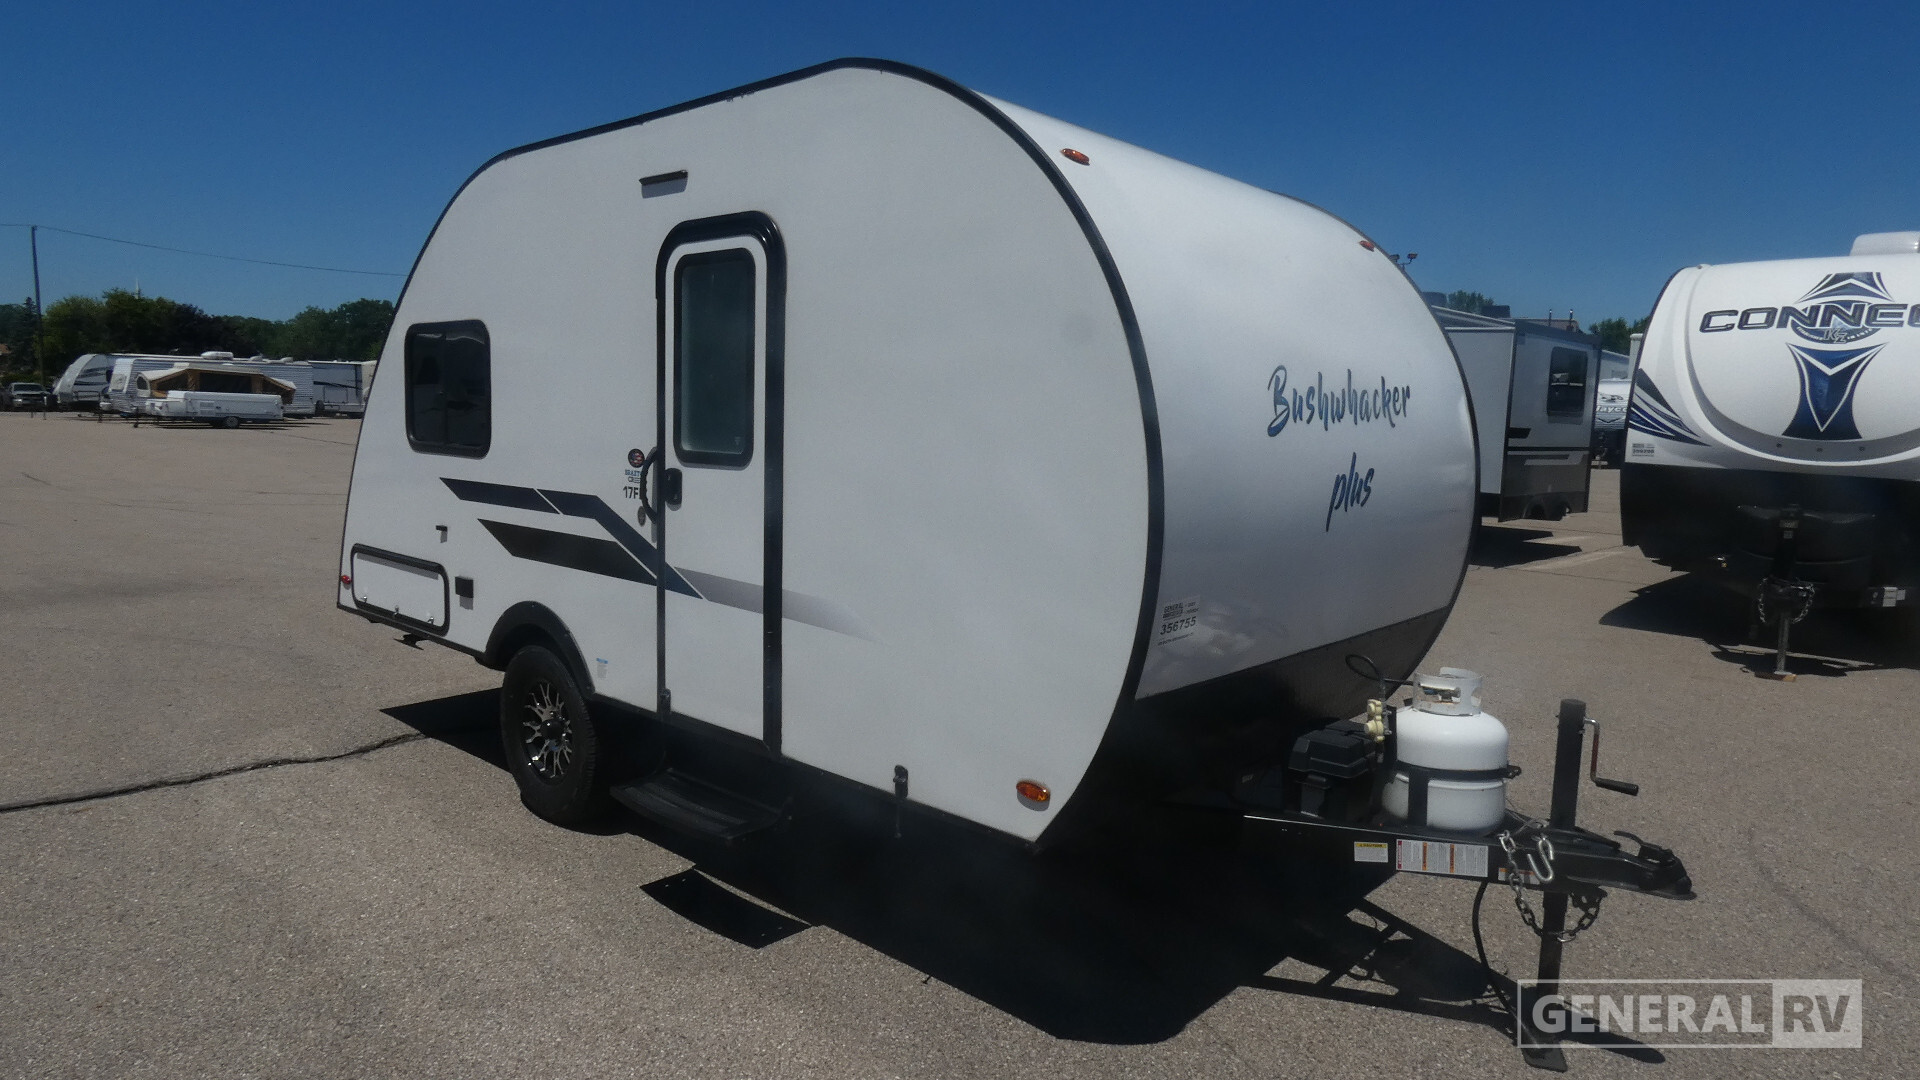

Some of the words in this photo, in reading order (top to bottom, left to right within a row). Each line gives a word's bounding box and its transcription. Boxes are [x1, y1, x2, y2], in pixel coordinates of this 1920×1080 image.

[1700, 303, 1920, 333] CONNE
[1267, 365, 1411, 437] Bushwhacker
[1325, 452, 1375, 532] plus
[1160, 616, 1196, 635] 356755
